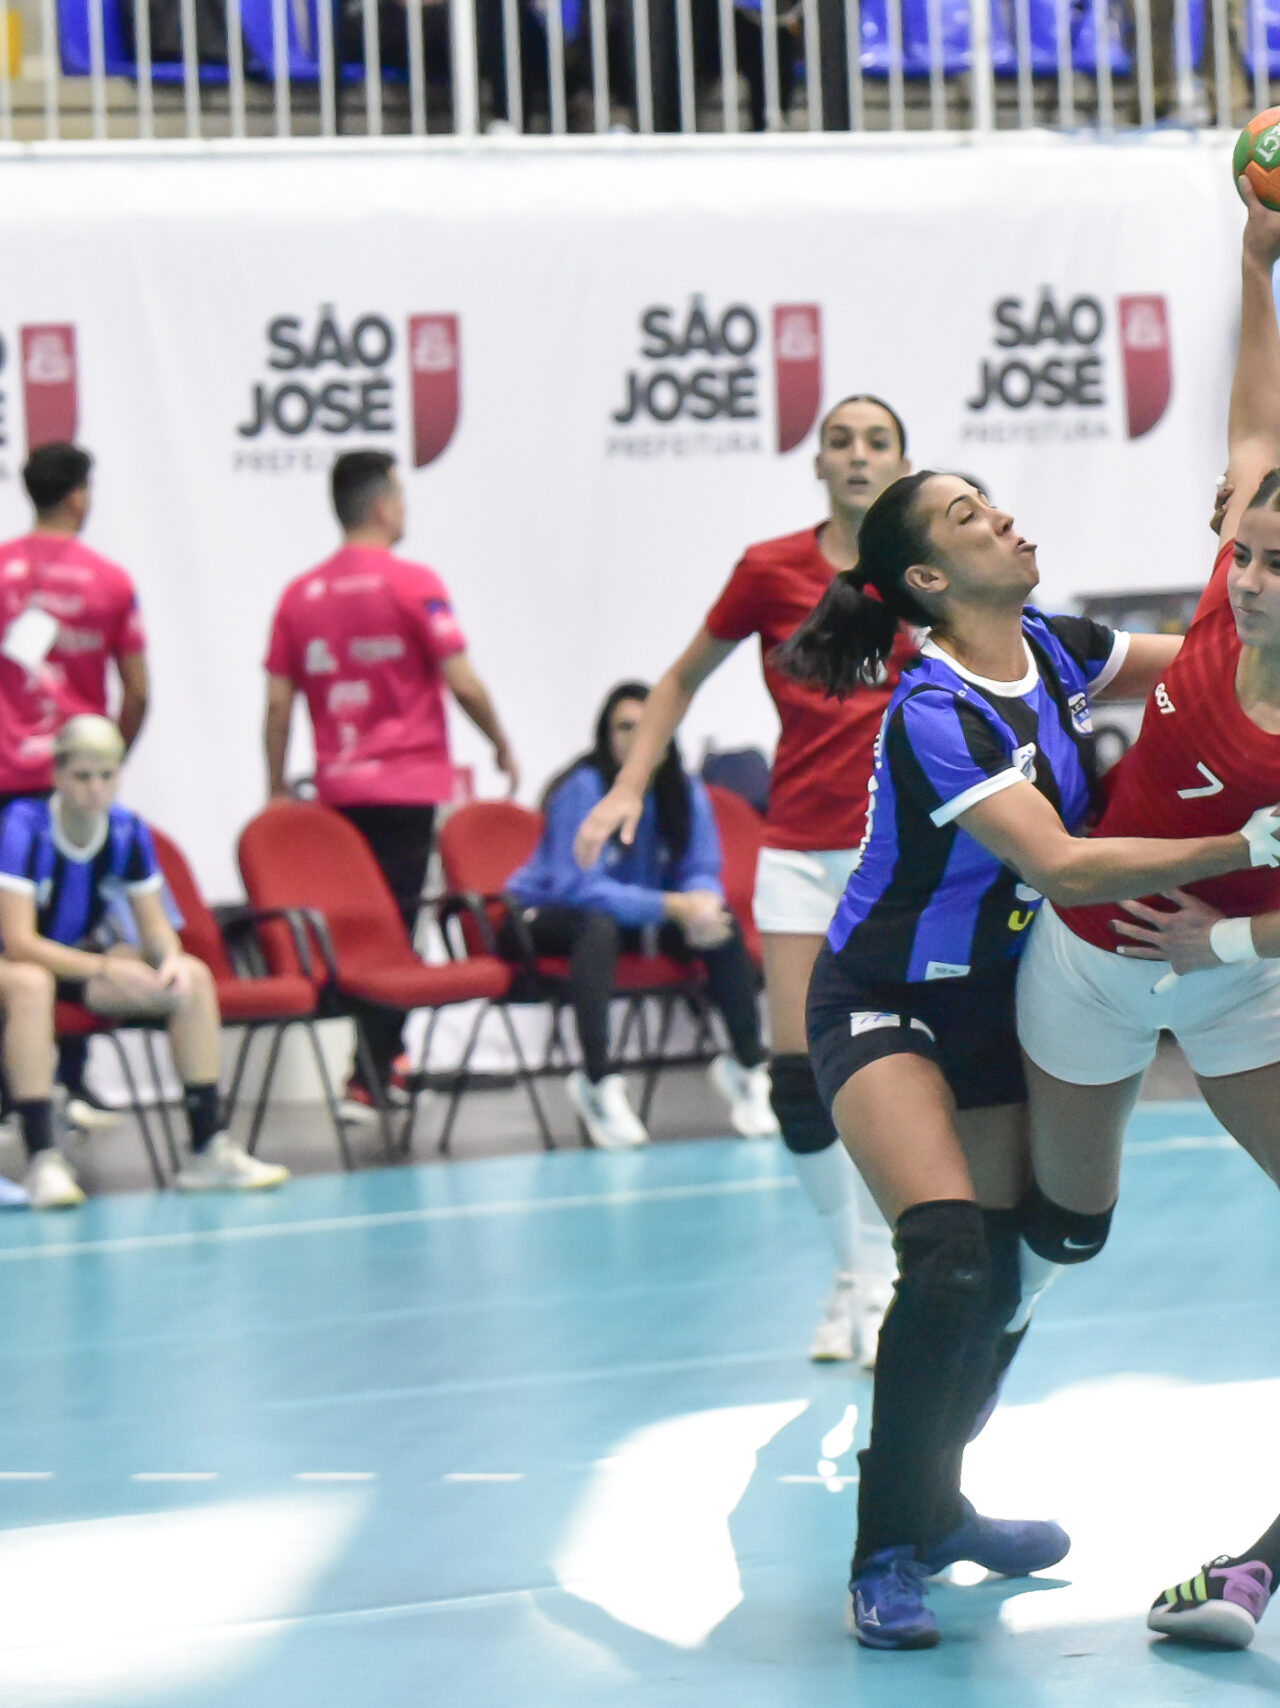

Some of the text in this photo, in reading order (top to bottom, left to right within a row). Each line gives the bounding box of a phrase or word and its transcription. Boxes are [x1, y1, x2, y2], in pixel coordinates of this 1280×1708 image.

[266, 304, 395, 371] SÃO
[640, 294, 760, 360] SÃO
[993, 286, 1105, 348] SÃO
[1177, 761, 1224, 800] 7
